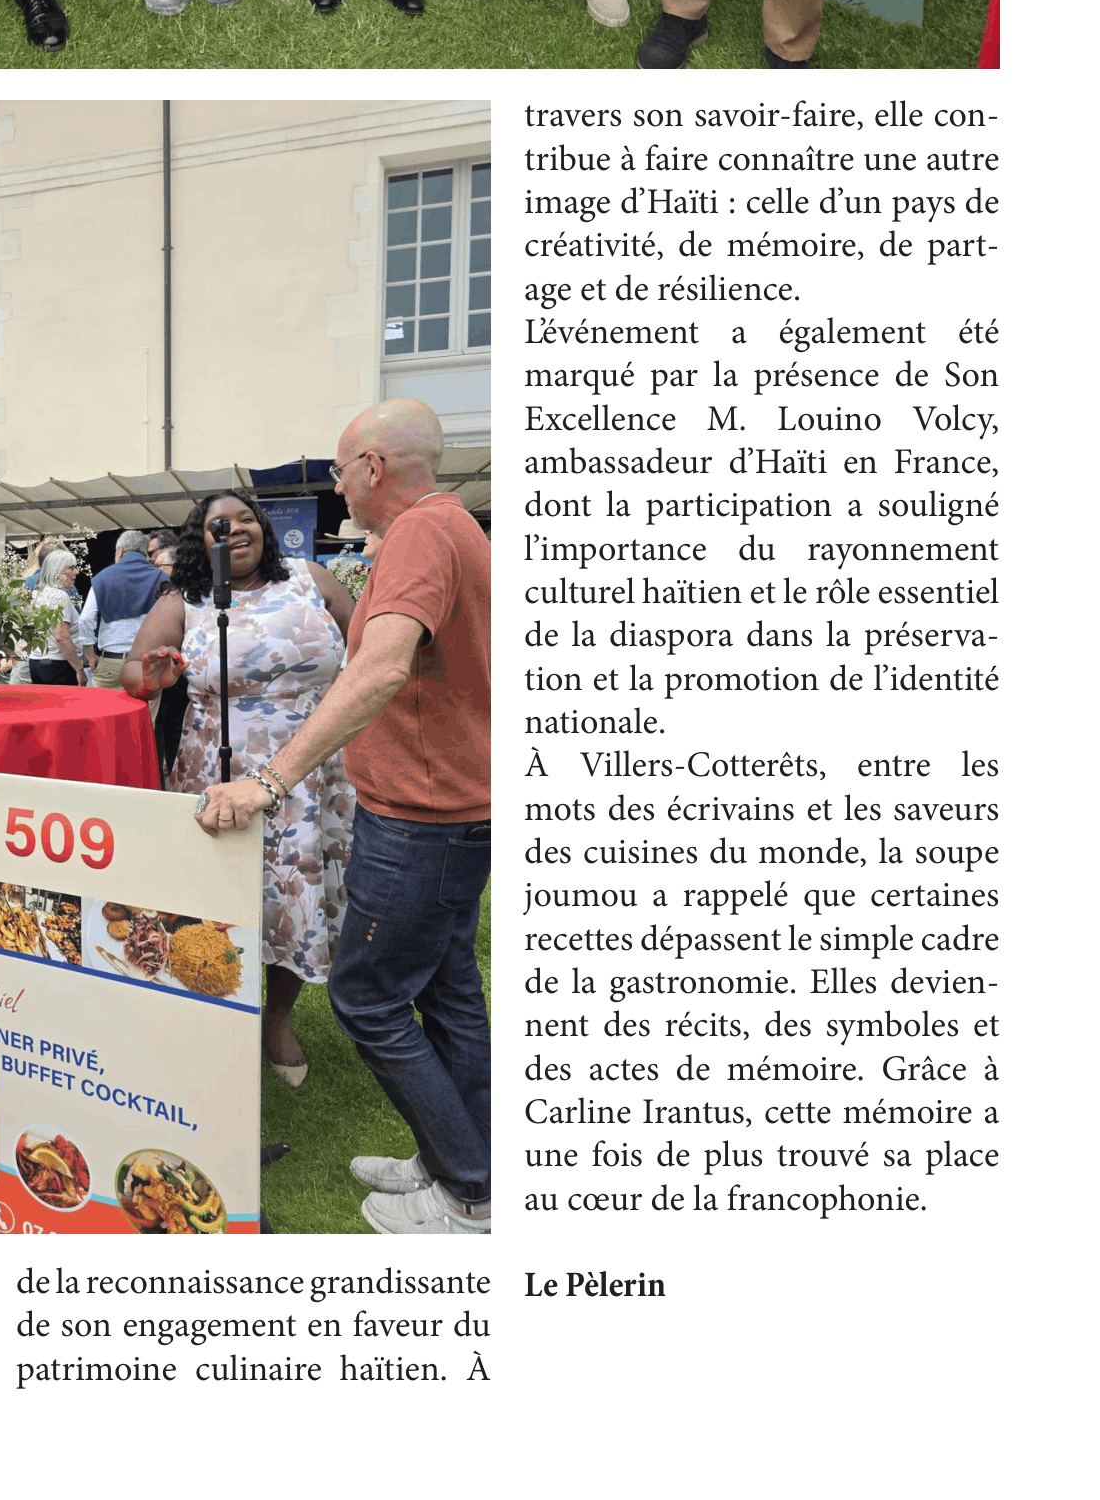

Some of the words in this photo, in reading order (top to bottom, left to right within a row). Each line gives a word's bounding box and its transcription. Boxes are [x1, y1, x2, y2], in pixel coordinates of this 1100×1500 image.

[525, 232, 663, 260] créativité,
[679, 230, 711, 257] de
[727, 232, 863, 260] mémoire,
[880, 230, 912, 257] de
[928, 235, 997, 265] part-
[525, 404, 675, 431] Excellence
[707, 406, 745, 431] M.
[778, 406, 881, 431] Louino
[913, 404, 998, 439] Volcy,
[5, 806, 114, 870] 509
[525, 929, 632, 951] recettes
[641, 924, 781, 959] dépassent
[788, 924, 811, 951] le
[820, 924, 913, 959] simple
[922, 924, 998, 951] cadre
[39, 1039, 105, 1076] PRIVÉ,
[1, 1054, 76, 1091] BUFFET
[81, 1078, 198, 1132] COCKTAIL,
[17, 1267, 49, 1294] de
[56, 1267, 80, 1293] la
[87, 1270, 303, 1294] reconnaissance
[311, 1267, 490, 1302] grandissante
[525, 1273, 557, 1297] Le
[566, 1271, 665, 1297] Pèlerin
